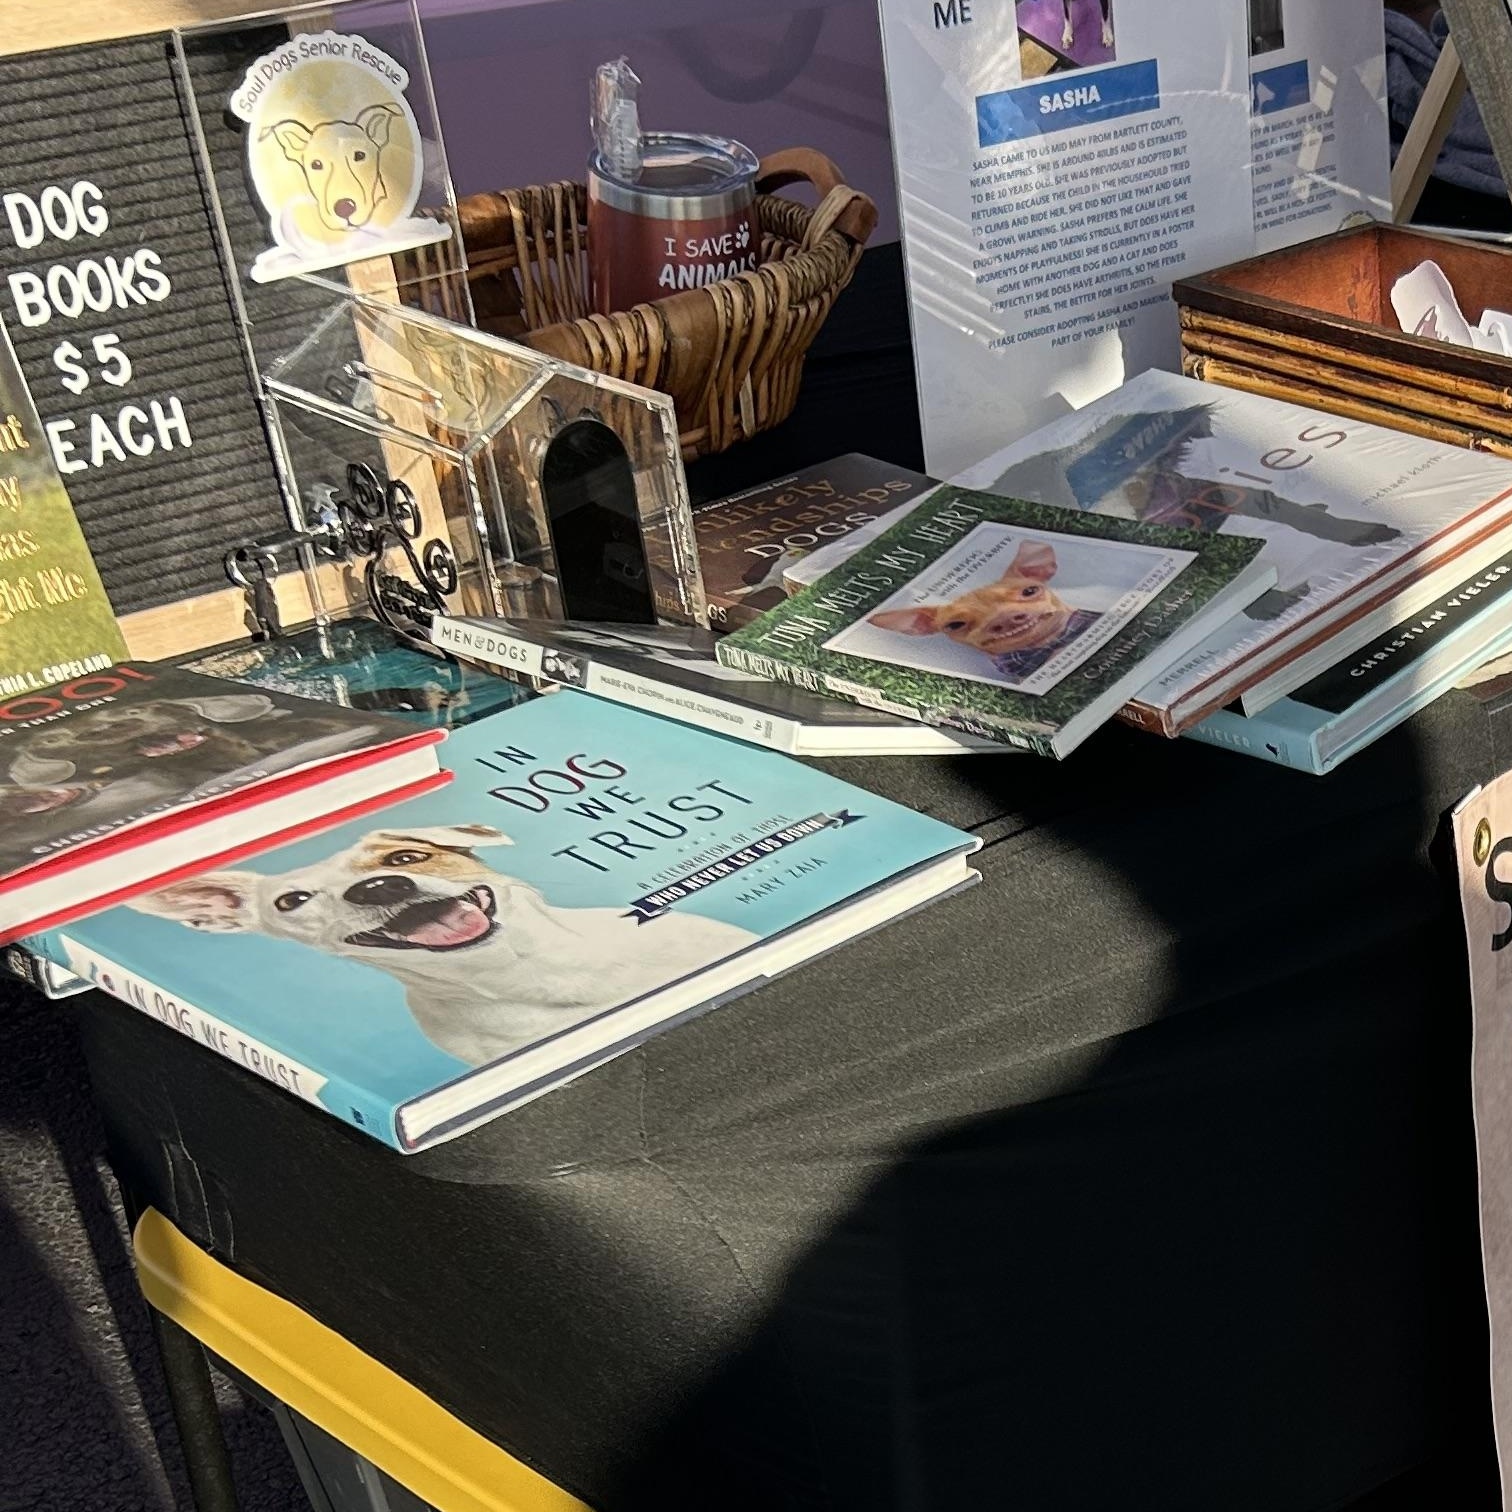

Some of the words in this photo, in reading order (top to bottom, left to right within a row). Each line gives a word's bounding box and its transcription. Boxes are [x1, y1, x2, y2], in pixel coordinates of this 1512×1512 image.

[933, 0, 972, 29] ME
[239, 75, 266, 112] Soul
[261, 49, 299, 80] Dogs
[299, 38, 349, 58] Senior
[352, 43, 402, 85] Rescue
[1039, 85, 1101, 114] SASHA
[972, 156, 999, 171] SASHA
[1000, 150, 1025, 165] CAME
[1025, 147, 1038, 159] TO
[1038, 145, 1049, 156] US
[1050, 141, 1068, 154] MID
[1068, 136, 1087, 150] MAY
[1087, 130, 1112, 145] FROM
[1112, 122, 1149, 140] BARTLETT
[4, 181, 109, 249] DOG
[971, 225, 983, 236] TO
[984, 219, 1009, 233] CLIMB
[1011, 214, 1028, 227] AND
[1029, 209, 1048, 222] RIDE
[1068, 201, 1083, 213] SHE
[1084, 197, 1099, 209] DID
[1099, 193, 1117, 205] NOT
[1117, 189, 1133, 201] LIKE
[1134, 184, 1153, 197] THAT
[1154, 180, 1171, 192] AND
[1172, 175, 1191, 188] GAVE
[1003, 244, 1039, 262] NAPPING
[1040, 239, 1058, 252] AND
[1058, 231, 1087, 247] TAKING
[1122, 218, 1139, 231] BUT
[1139, 213, 1159, 226] DOES
[1159, 208, 1179, 221] HAVE
[1180, 204, 1195, 216] HER
[664, 237, 677, 256] I
[685, 233, 733, 258] SAVE
[996, 280, 1020, 295] HOME
[1022, 274, 1043, 288] WITH
[1044, 264, 1081, 282] ANOTHER
[1082, 259, 1100, 272] DOG
[1101, 255, 1117, 267] AND
[1125, 249, 1140, 261] CAT
[1141, 244, 1158, 257] AND
[1158, 239, 1178, 252] DOES
[8, 249, 172, 328] BOOKS
[46, 396, 193, 474] EACH
[745, 512, 880, 559] DOGS
[37, 566, 89, 605] Me
[757, 614, 831, 649] TUNA
[814, 572, 895, 615] MELTS
[875, 545, 927, 572] MY
[909, 498, 985, 545] HEART
[1350, 610, 1447, 677] CHRISTIAN
[1447, 565, 1511, 608] VIELER
[42, 654, 113, 684] COPELAND
[724, 645, 748, 668] TUNA
[748, 653, 776, 678] MELTS
[775, 660, 793, 681] MY
[791, 666, 819, 692] HEART
[1159, 648, 1220, 686] MERRELL
[475, 745, 538, 773] IN
[1200, 726, 1252, 748] VIELER
[487, 753, 628, 813] DOG
[564, 785, 646, 821] WE
[552, 779, 754, 872] TRUST
[651, 842, 731, 887] CELEBRATION
[733, 832, 750, 845] OF
[752, 814, 793, 836] THOSE
[645, 885, 685, 908] WHO
[682, 862, 735, 893] NEVER
[731, 848, 761, 869] LET
[755, 837, 783, 854] US
[780, 819, 825, 843] DOWN
[736, 878, 786, 905] MARY
[786, 857, 828, 880] ZAIA
[126, 979, 149, 1011] IN
[154, 992, 194, 1038] DOG
[201, 1020, 231, 1058] WE
[238, 1041, 302, 1095] TRUST
